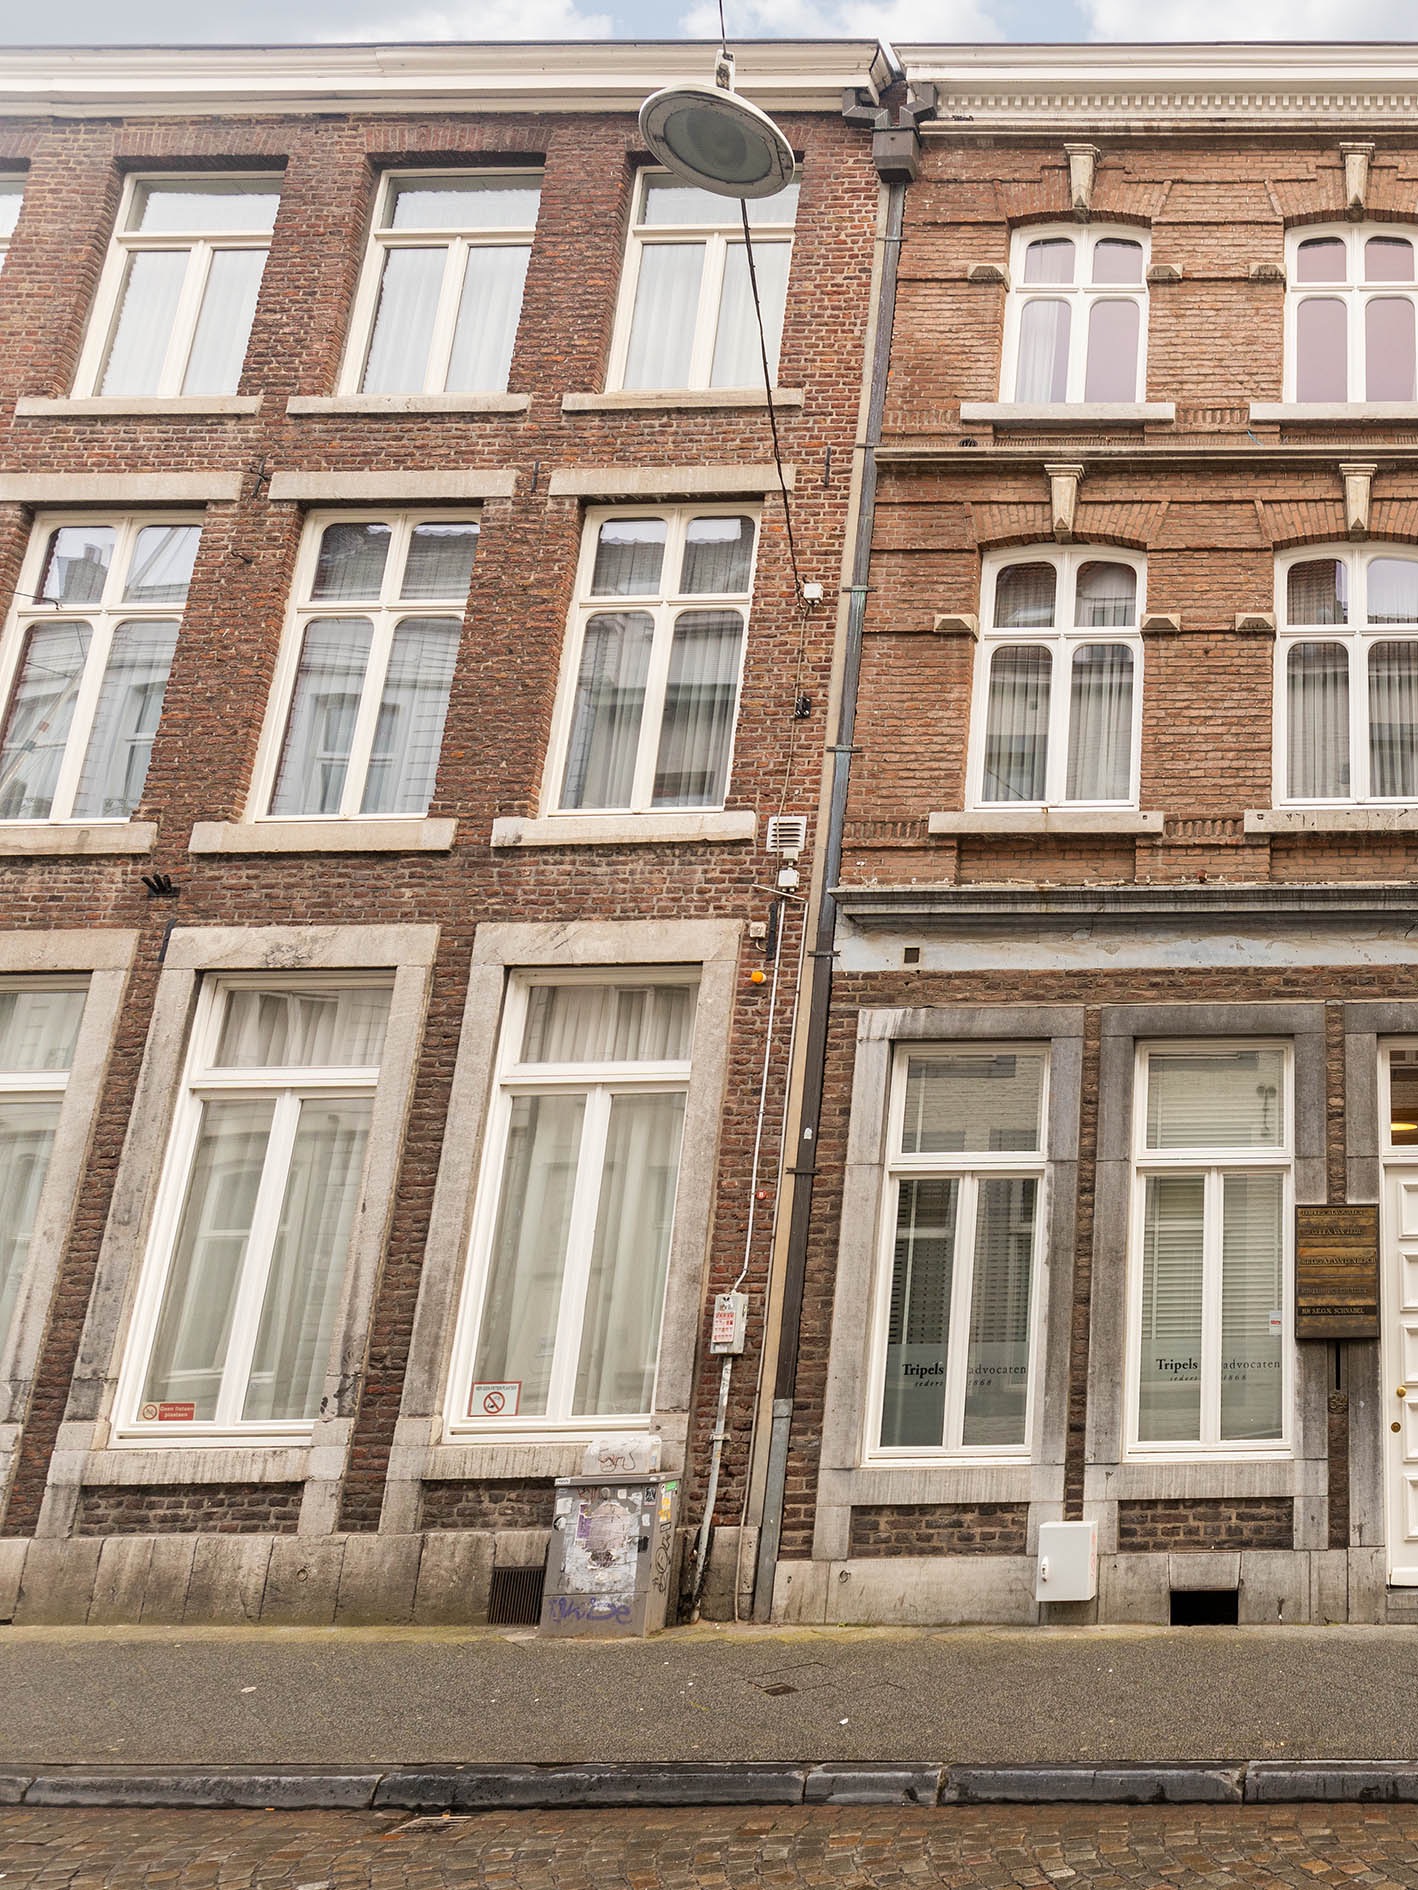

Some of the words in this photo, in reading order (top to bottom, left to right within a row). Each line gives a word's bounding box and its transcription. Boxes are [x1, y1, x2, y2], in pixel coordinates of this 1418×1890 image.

[902, 1363, 944, 1379] Tripels
[968, 1363, 1027, 1375] advocaten
[1156, 1358, 1198, 1374] Tripels
[1223, 1359, 1280, 1369] advocaten
